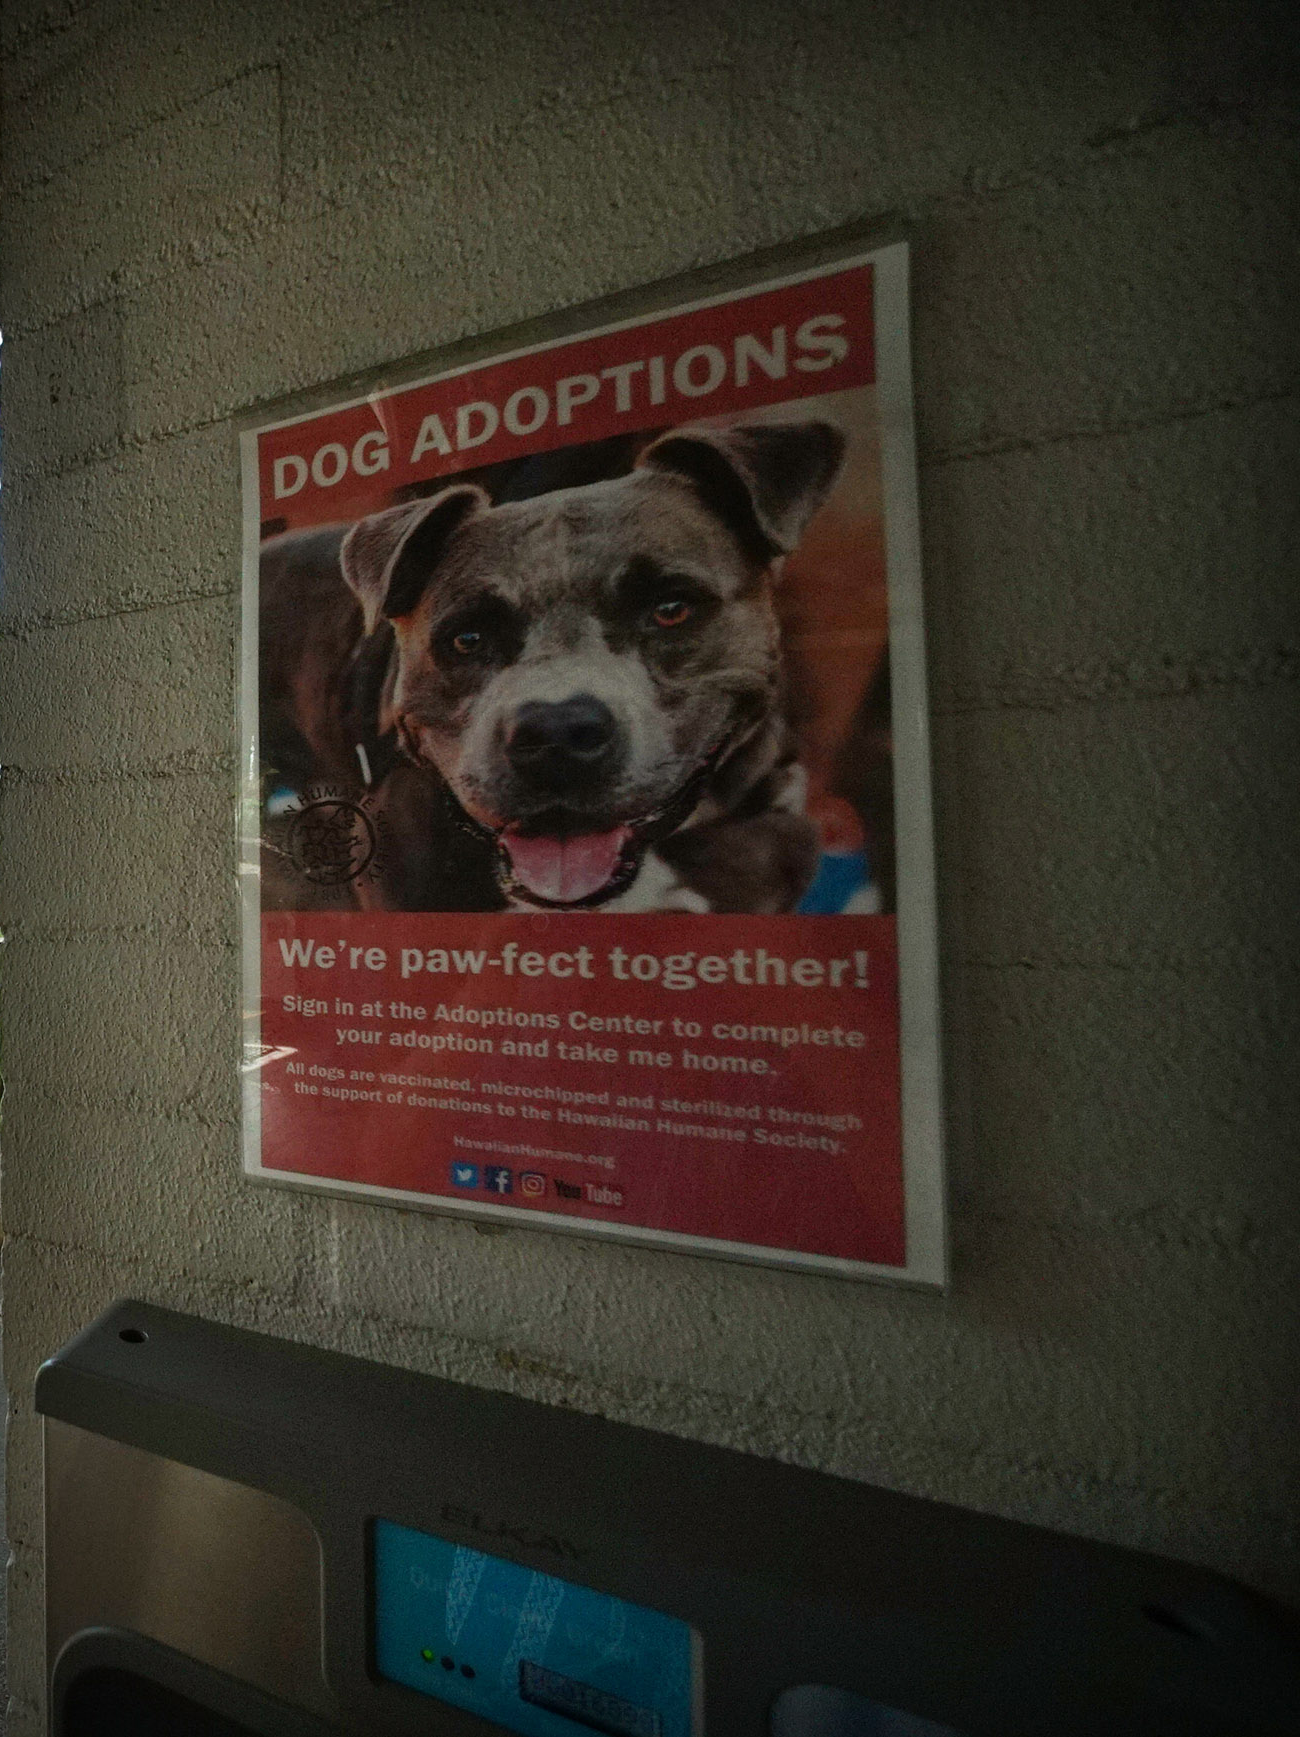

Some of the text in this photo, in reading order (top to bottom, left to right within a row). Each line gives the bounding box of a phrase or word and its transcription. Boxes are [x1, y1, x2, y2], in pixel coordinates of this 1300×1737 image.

[272, 313, 850, 500] DOG ADOPTIONS
[278, 938, 870, 990] We’re paw-fect together!
[282, 994, 867, 1049] Sign in at the Adoptions Center to complete
[335, 1027, 779, 1076] your adoption and take me home.
[285, 1061, 304, 1075] All
[309, 1063, 345, 1081] dogs
[349, 1068, 375, 1082] are
[481, 1081, 609, 1107] microchipped
[616, 1095, 654, 1111] and
[660, 1098, 761, 1121] sterilized
[767, 1106, 863, 1132] through
[294, 1081, 847, 1155] the support of donations to the Hawaiian Humane Society.
[453, 1135, 617, 1170] HawaiianHumane.org
